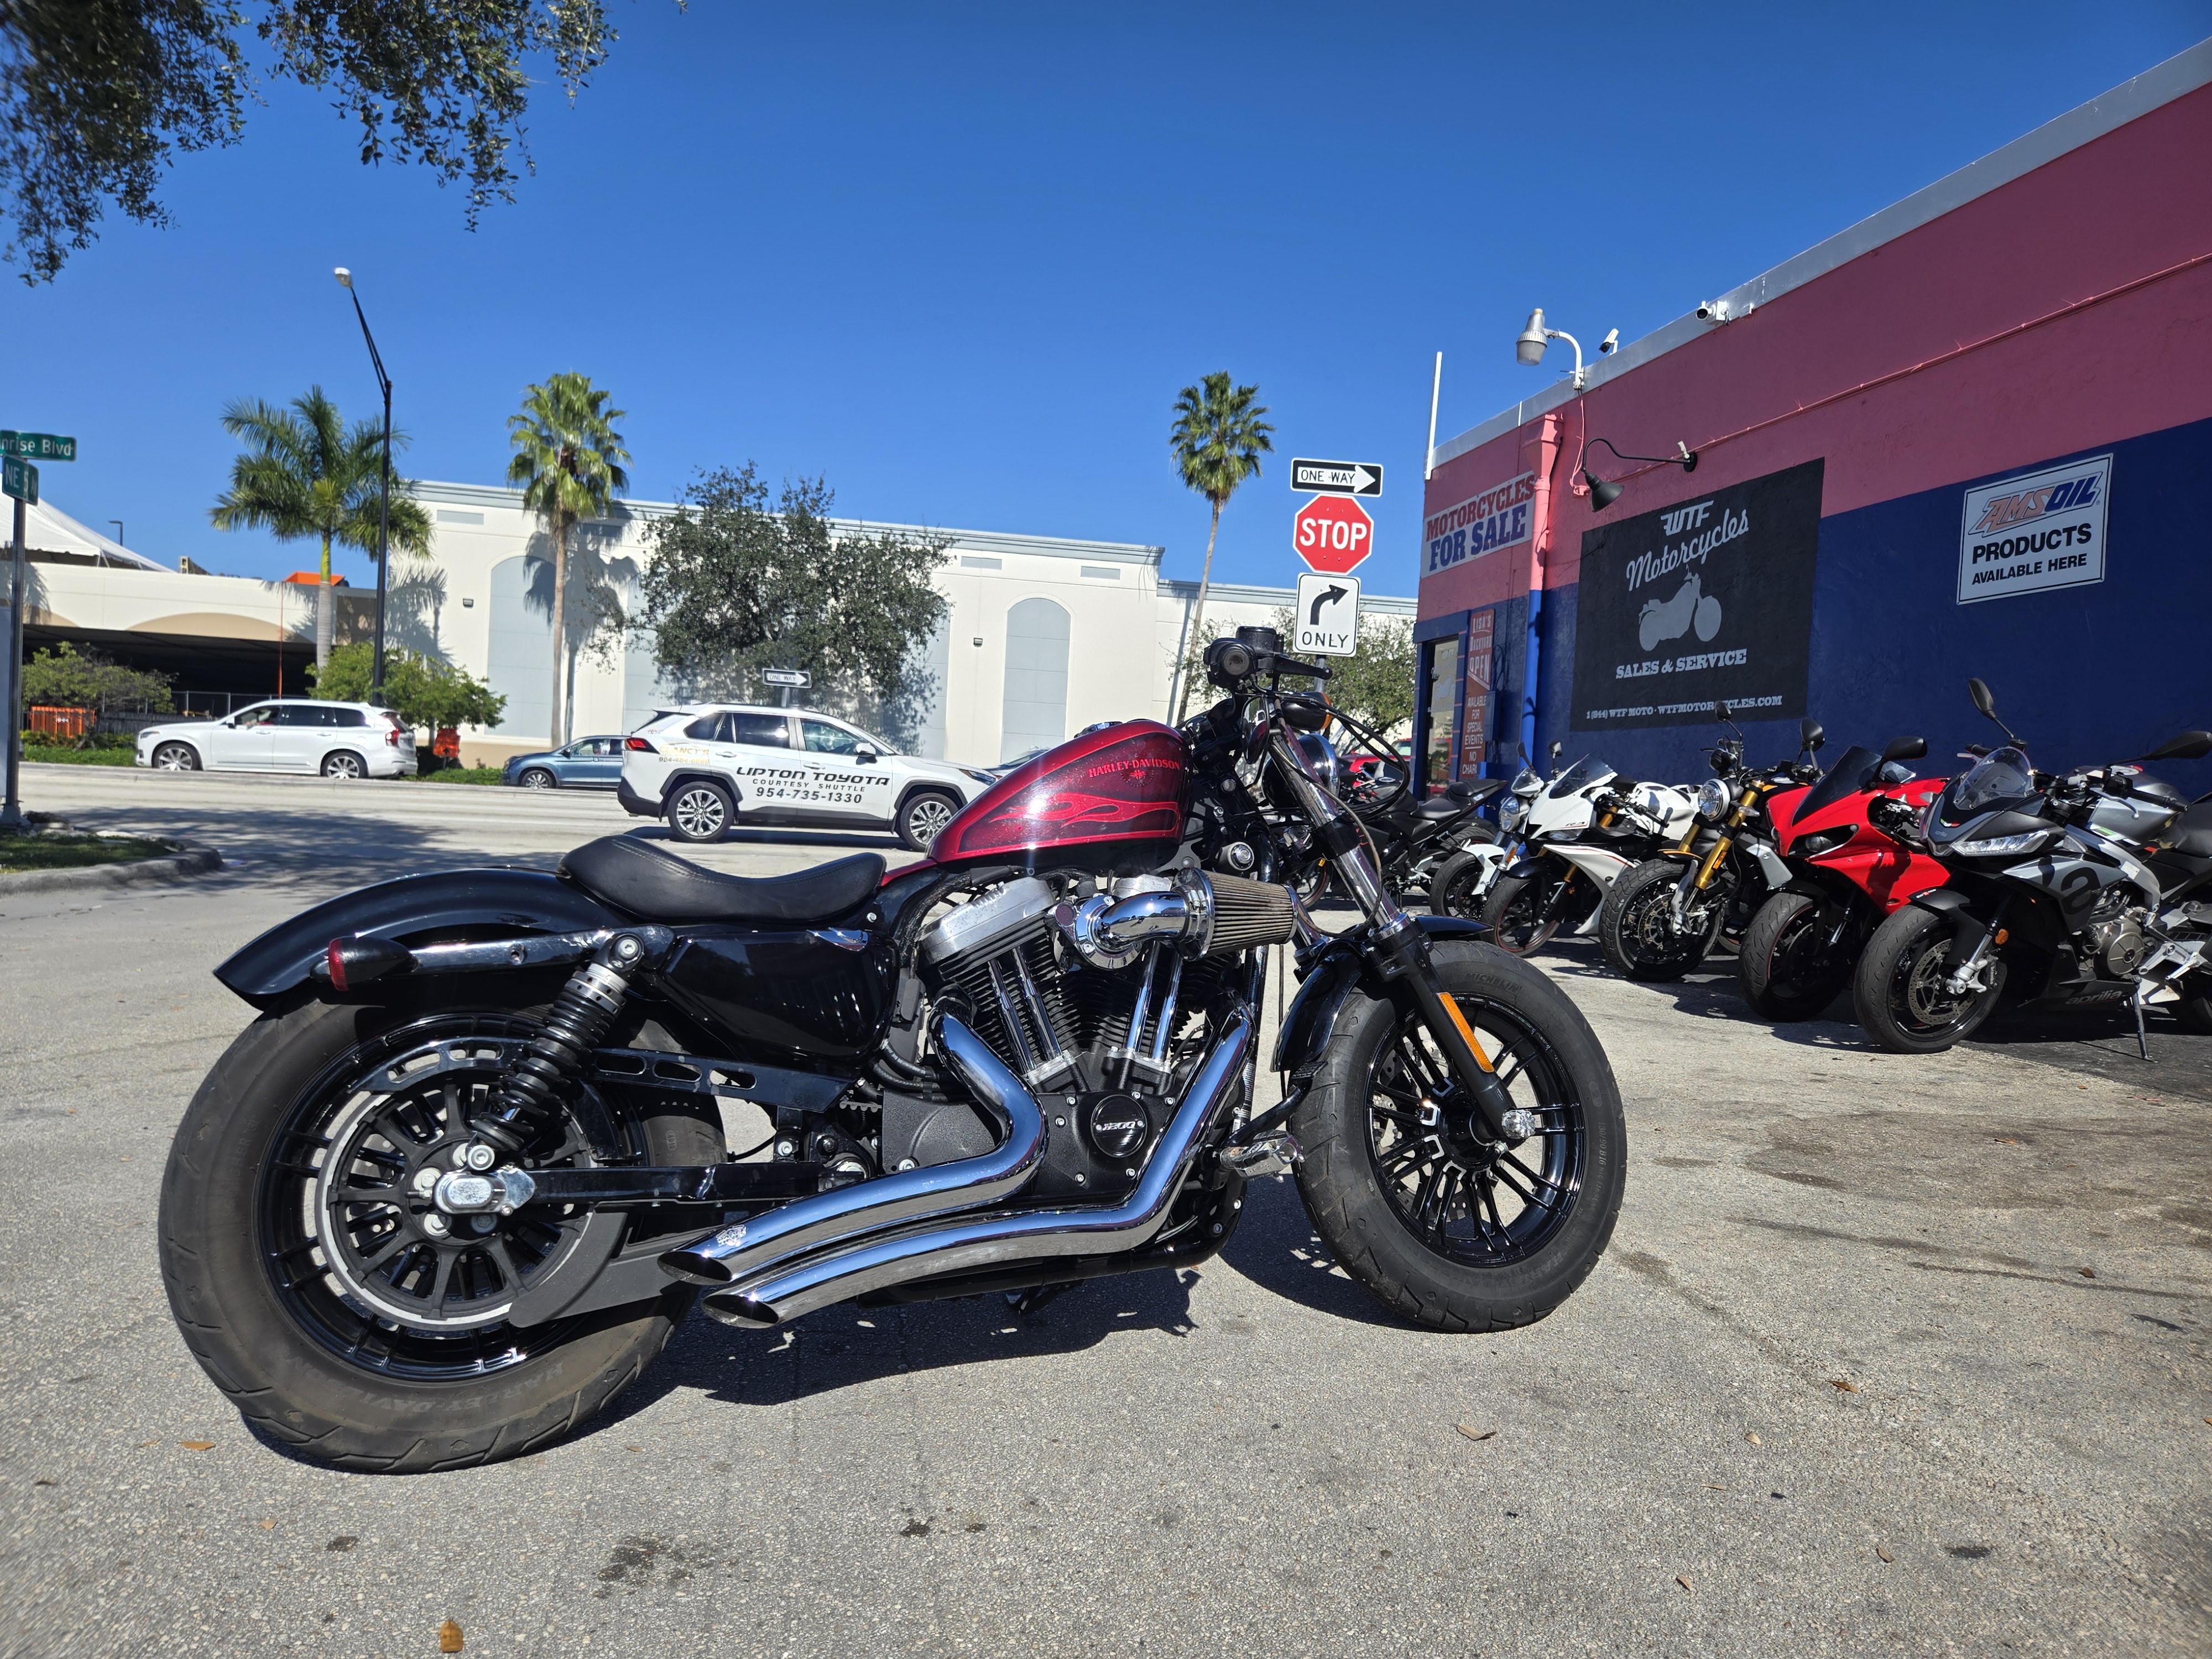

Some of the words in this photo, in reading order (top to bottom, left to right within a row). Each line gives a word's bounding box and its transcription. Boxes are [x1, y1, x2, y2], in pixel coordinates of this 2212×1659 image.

[0, 436, 35, 453] nrise
[42, 439, 71, 456] Blvd
[5, 464, 20, 489] NE
[23, 471, 29, 493] 5
[1301, 469, 1324, 482] ONE
[1331, 472, 1355, 484] WAY
[1426, 474, 1535, 542] MOTORCYCLES
[1975, 476, 2098, 533] AMSOIL
[1661, 500, 1714, 536] WTF
[1300, 518, 1367, 551] STOP
[1429, 529, 1466, 572] FOR
[1470, 503, 1527, 556] SALE
[1972, 523, 2092, 565] PRODUCTS
[1626, 508, 1749, 592] Motorcycles
[1971, 561, 2043, 585] AVAILABLE
[2048, 553, 2088, 572] HERE
[1302, 631, 1349, 649] ONLY
[1469, 654, 1490, 683] OPEN
[1615, 660, 1660, 680] SALES
[1661, 659, 1674, 674] &
[1675, 649, 1747, 672] SERVICE
[1467, 695, 1486, 708] AVAILABLE
[1586, 711, 1590, 719] 1
[1591, 709, 1608, 720] (844)
[1609, 708, 1627, 717] WTF
[1628, 706, 1653, 717] MOTO
[1657, 696, 1783, 714] WTFMOTORCLES.COM
[1472, 709, 1480, 720] FOR
[1467, 721, 1483, 733] SPECIAL
[1464, 733, 1484, 745] EVENTS
[1469, 751, 1477, 762] NO
[736, 766, 806, 780] LIPTON
[813, 772, 890, 786] TOYOTA
[1088, 758, 1180, 778] HARLEY-DAVIDSON
[1462, 764, 1477, 775] CHAR
[753, 779, 810, 788] COURTESY
[818, 783, 866, 792] SHUTTLE
[756, 787, 862, 804] 954-735-1330
[1466, 973, 1521, 993] MICHELIN
[2065, 989, 2122, 1004] aprilia
[1103, 1121, 1136, 1131] 1200
[1598, 1121, 1607, 1149] 130/90
[1599, 1149, 1607, 1166] B16
